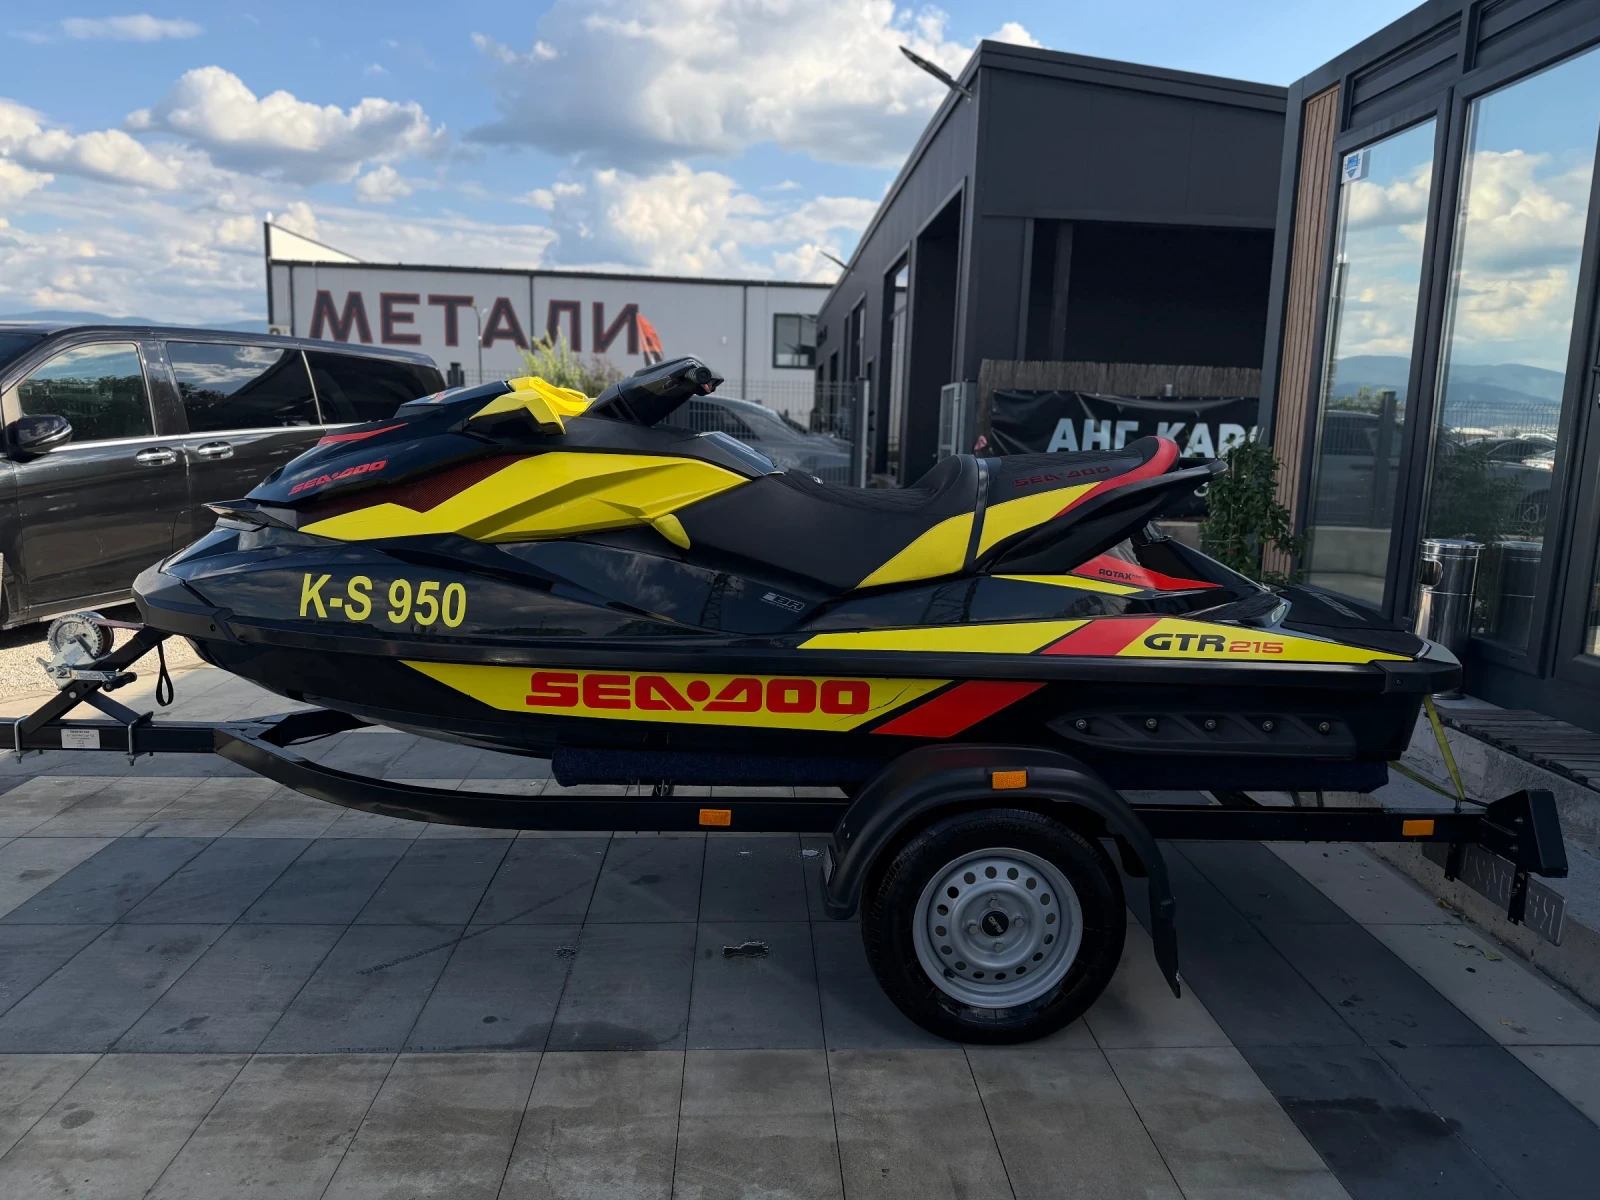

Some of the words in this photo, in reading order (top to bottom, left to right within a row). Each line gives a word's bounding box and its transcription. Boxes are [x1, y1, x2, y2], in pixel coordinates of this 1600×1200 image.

[308, 290, 639, 355] МЕТАЛИ
[1098, 568, 1132, 581] ROTAX
[299, 573, 373, 621] K-S
[387, 578, 467, 628] 950
[1143, 633, 1226, 652] GTR
[1228, 640, 1284, 654] 215
